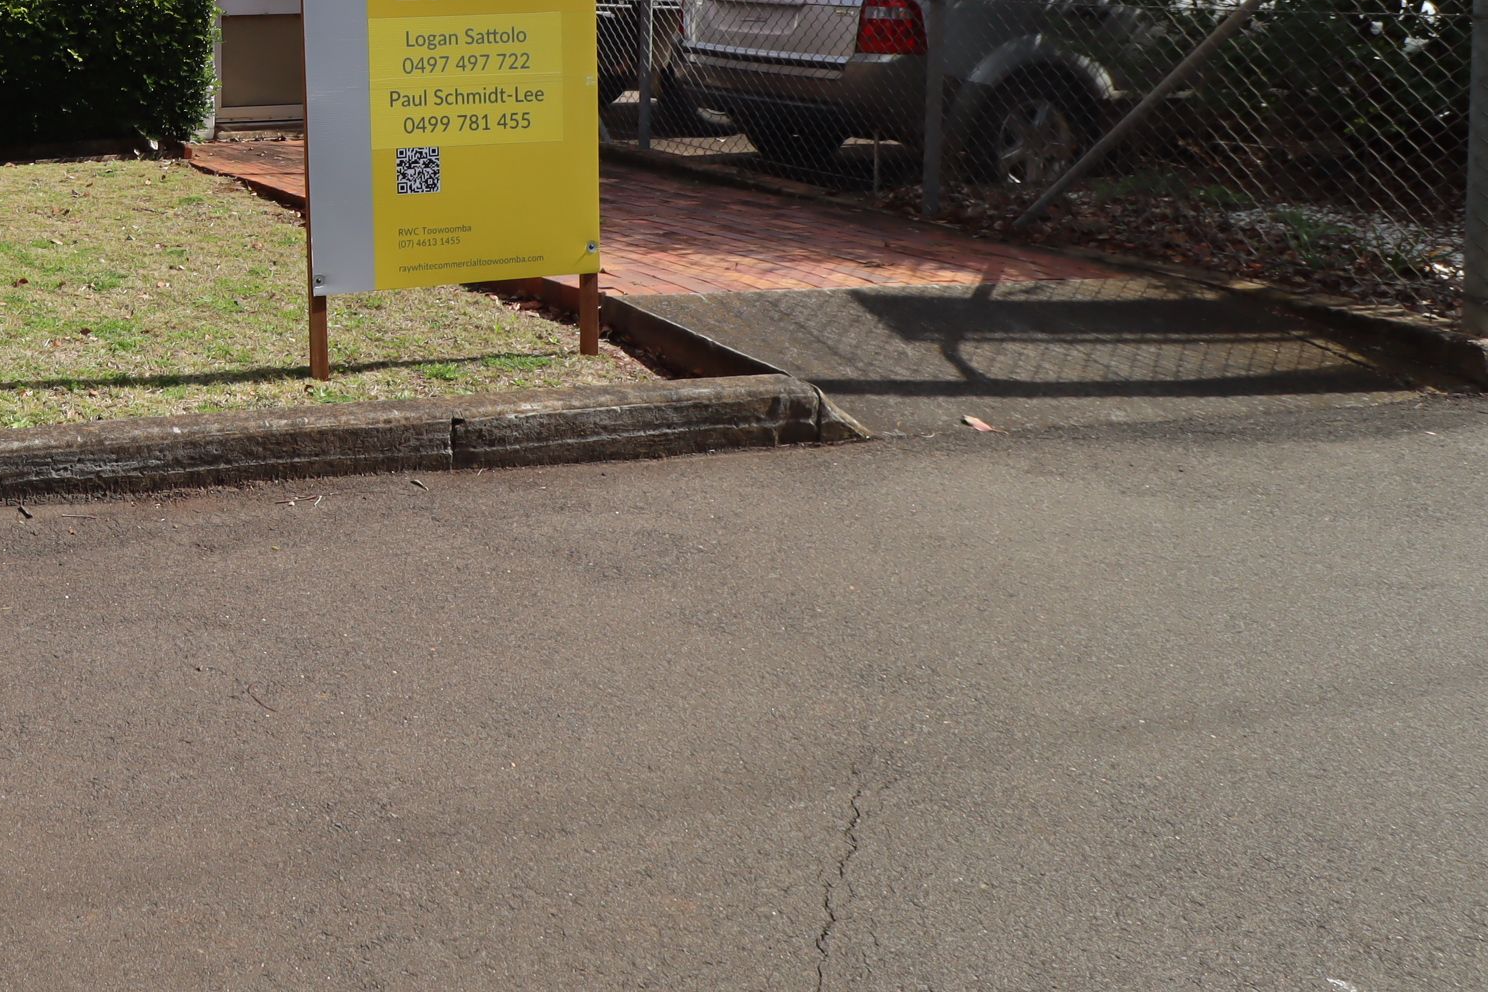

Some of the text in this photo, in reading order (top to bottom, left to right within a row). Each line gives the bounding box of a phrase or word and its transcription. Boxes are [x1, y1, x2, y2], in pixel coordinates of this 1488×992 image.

[405, 26, 527, 51] Logan Sattolo
[402, 52, 530, 74] 0497 497 722
[389, 86, 545, 108] Paul Schmidt-Lee
[403, 111, 531, 134] 0499 781 455
[398, 224, 472, 237] RWC Toowoomba
[398, 236, 461, 249] (07) 4613 1455
[398, 254, 544, 273] raywhitecommercialtoowoomba.com
